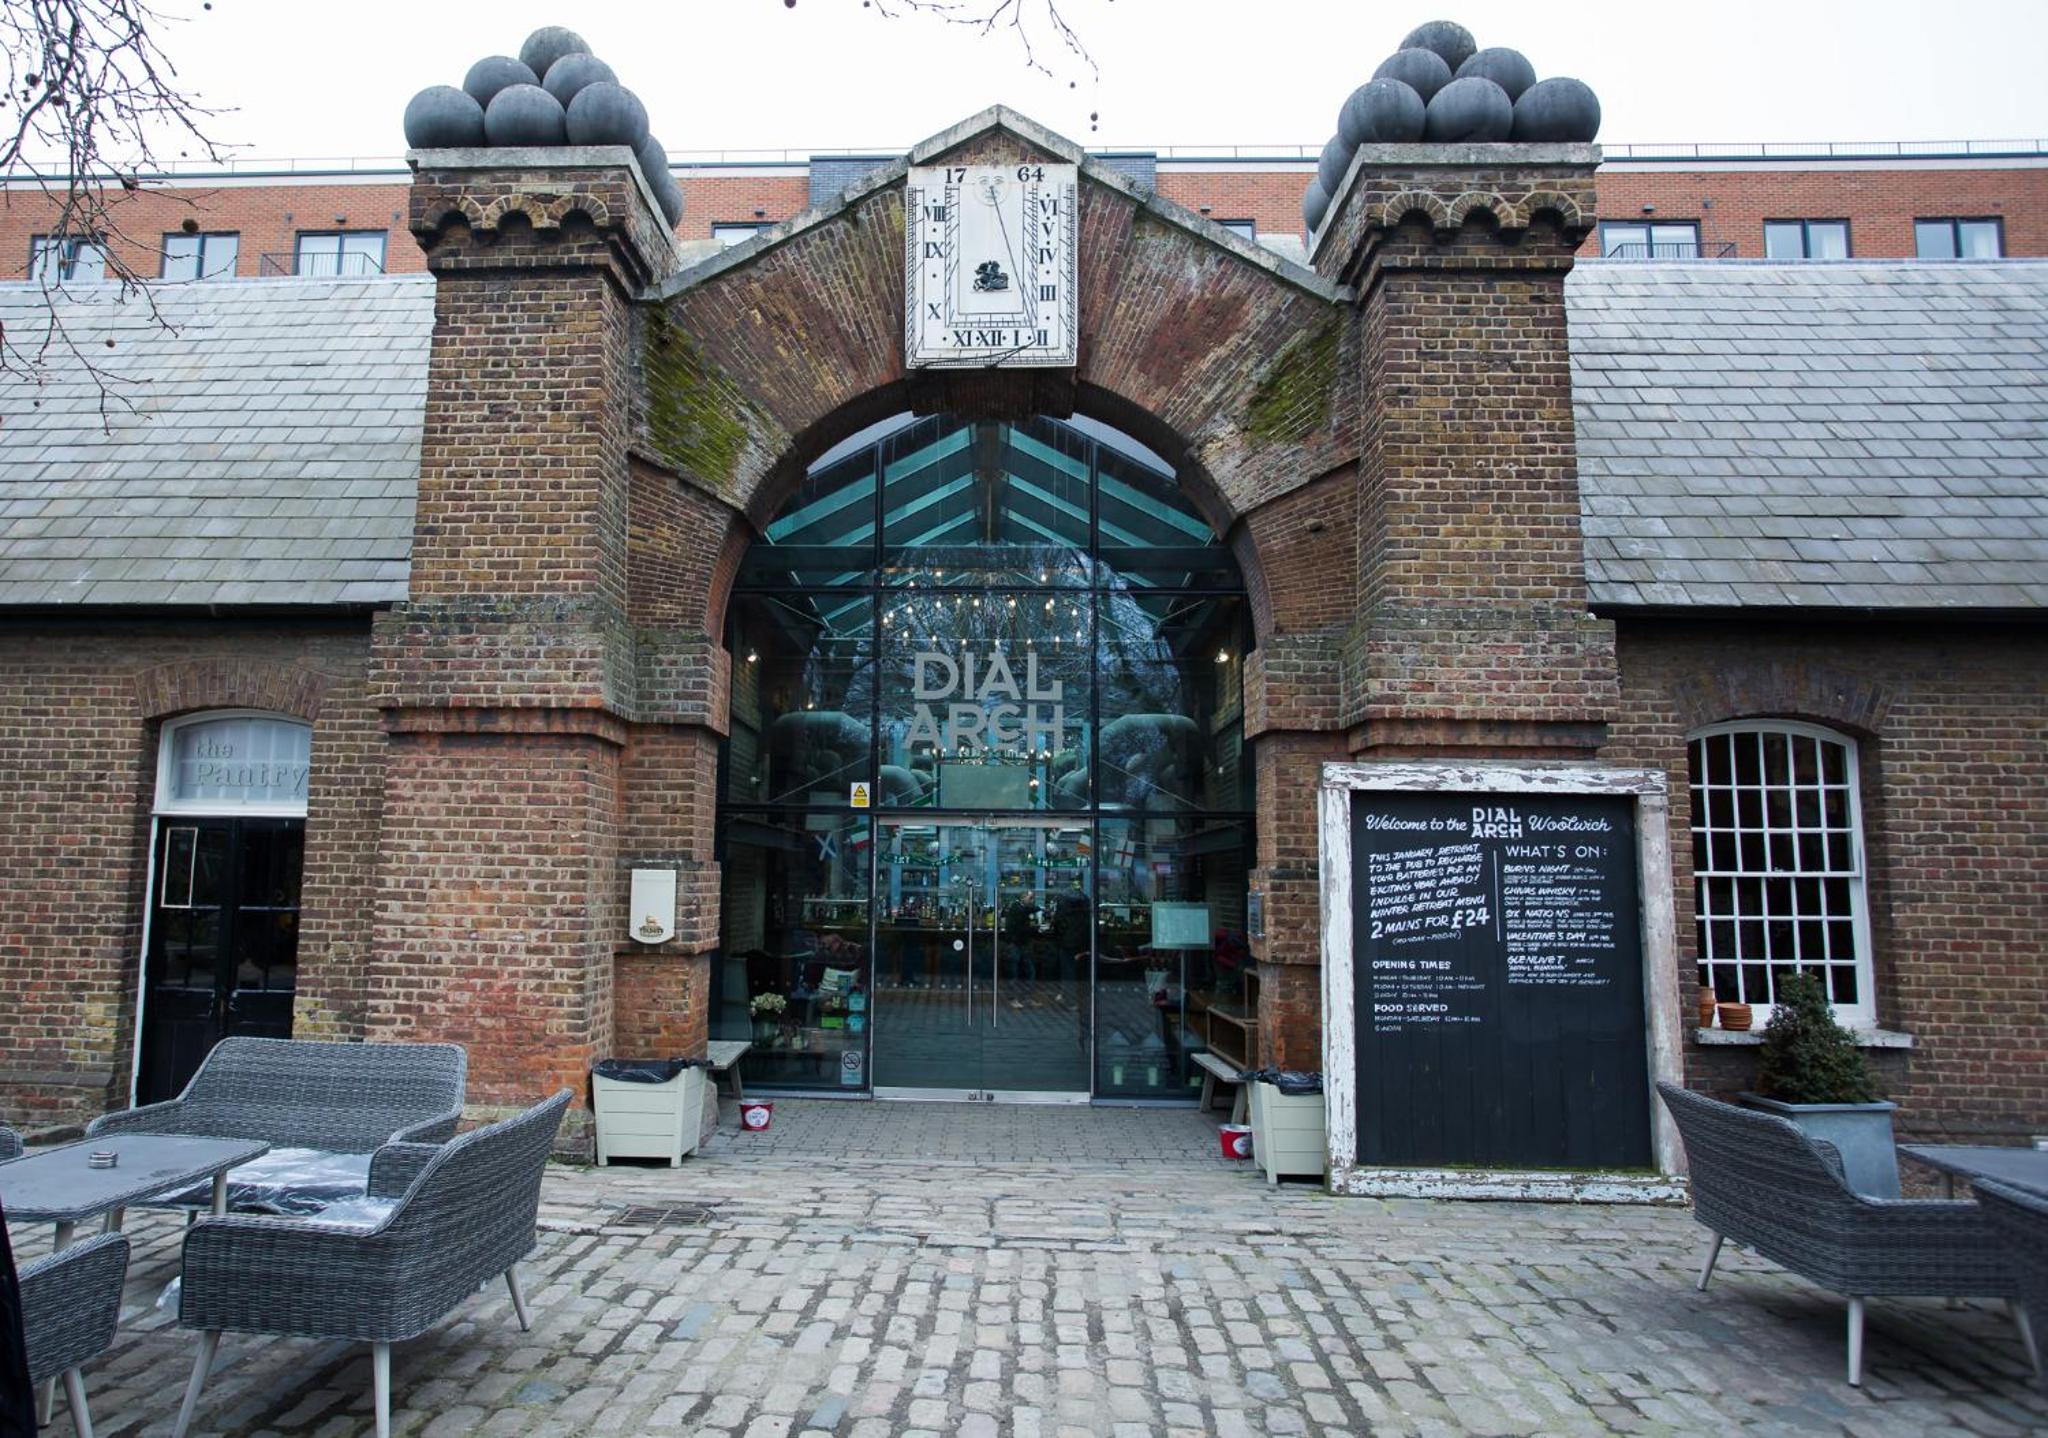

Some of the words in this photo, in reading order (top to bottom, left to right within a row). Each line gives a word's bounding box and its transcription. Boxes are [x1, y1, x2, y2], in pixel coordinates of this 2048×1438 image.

[945, 168, 967, 184] 17
[1017, 166, 1045, 182] 64
[924, 205, 946, 222] VIII
[1040, 200, 1058, 216] VI
[1041, 222, 1055, 238] V
[925, 242, 944, 259] IX
[1039, 248, 1057, 264] IV
[1039, 284, 1056, 301] III
[927, 303, 942, 320] X
[953, 329, 972, 347] XI
[979, 329, 1001, 346] XII
[914, 652, 1063, 700] DIAL
[902, 703, 1064, 752] ARCH
[1366, 814, 1427, 830] Welcome
[1430, 817, 1444, 830] to
[1445, 817, 1467, 831] the
[1472, 807, 1521, 823] DIAL
[1528, 814, 1613, 832] Woolwich
[1471, 823, 1523, 838] ARCH
[1369, 853, 1390, 863] THIS
[1505, 845, 1567, 858] WHAT'S
[1369, 864, 1383, 874] TO
[1370, 882, 1412, 896] EXCITING
[1419, 891, 1432, 901] IN
[1435, 887, 1460, 898] OUR
[1370, 920, 1384, 939] 2
[1384, 918, 1423, 934] MAINS
[1424, 915, 1449, 928] FOR
[1451, 907, 1491, 930] £24
[1372, 960, 1416, 970] OPENING
[1420, 960, 1452, 970] TIMES
[1374, 1003, 1404, 1012] FOOD
[1406, 1003, 1449, 1012] SERVED
